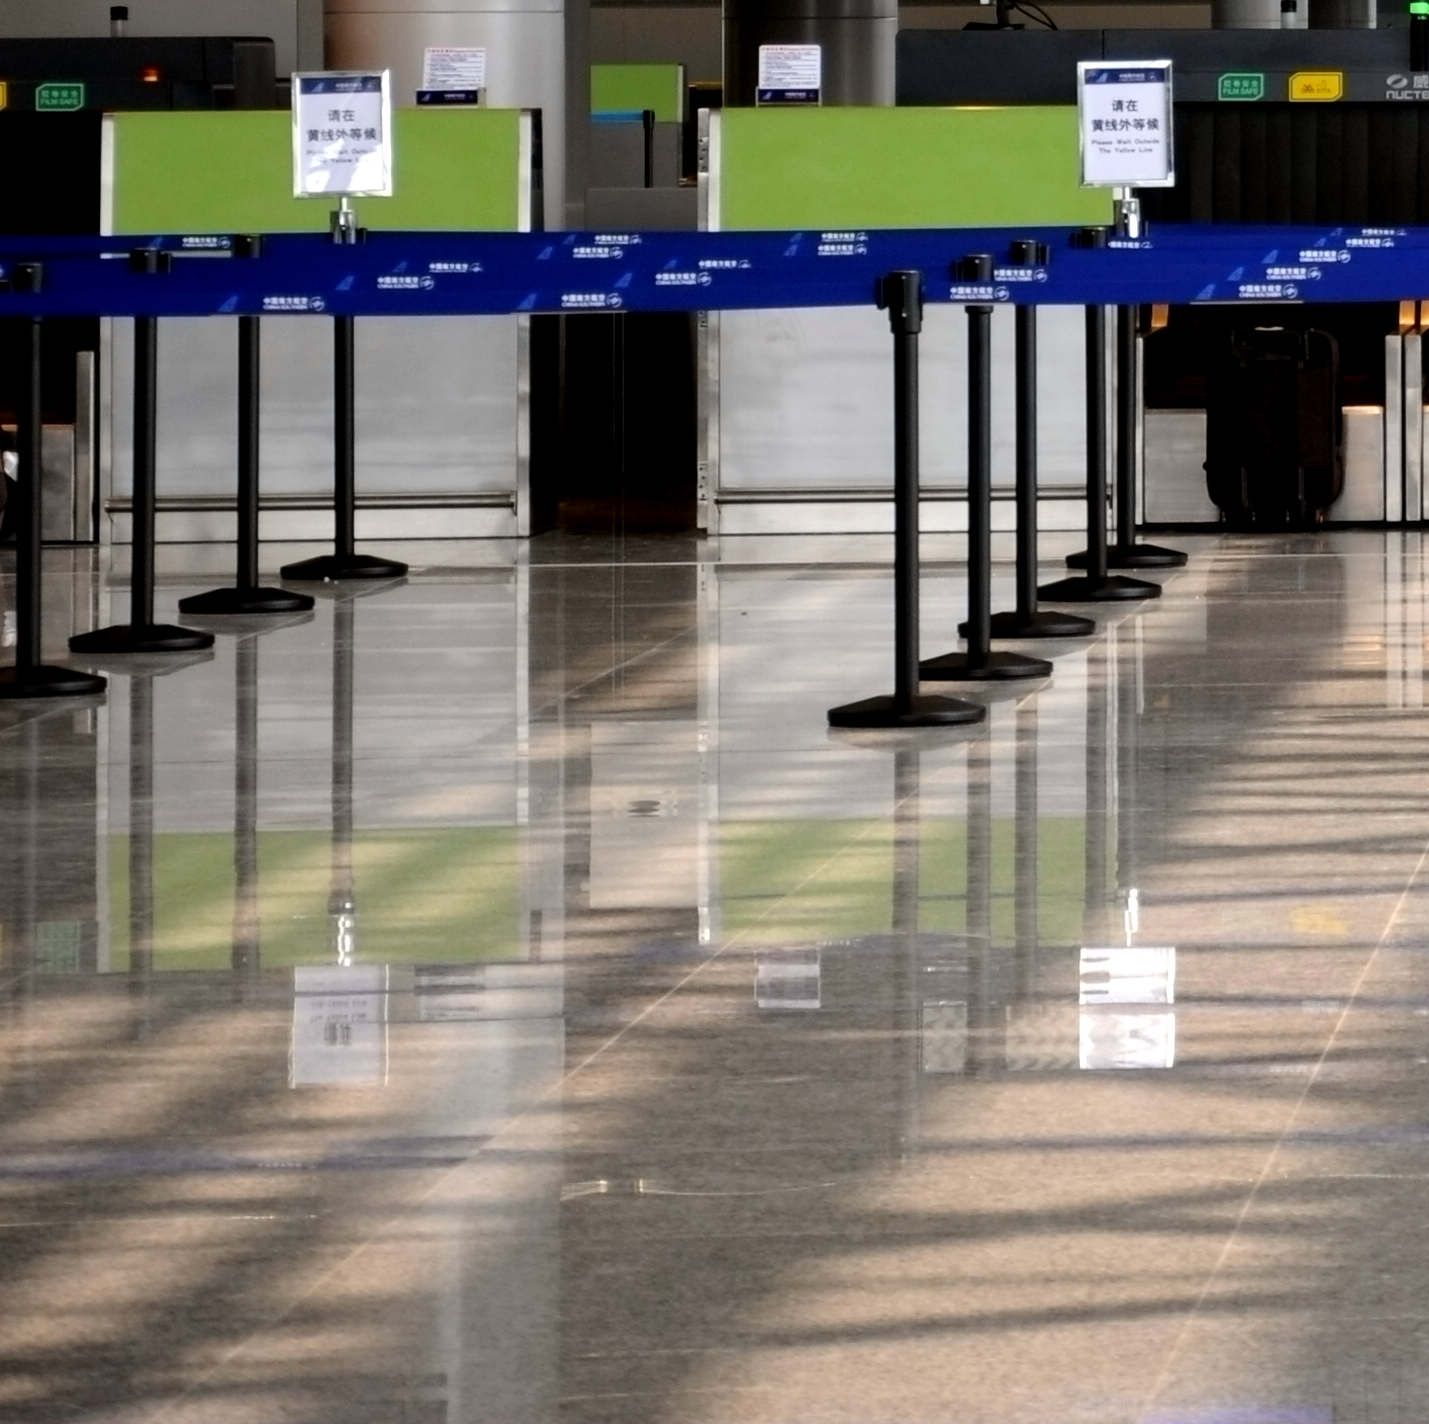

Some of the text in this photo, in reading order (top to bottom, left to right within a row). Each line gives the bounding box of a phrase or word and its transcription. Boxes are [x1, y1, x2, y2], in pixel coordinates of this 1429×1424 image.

[1112, 100, 1137, 112] 请在
[1092, 118, 1158, 131] 黄线外等候
